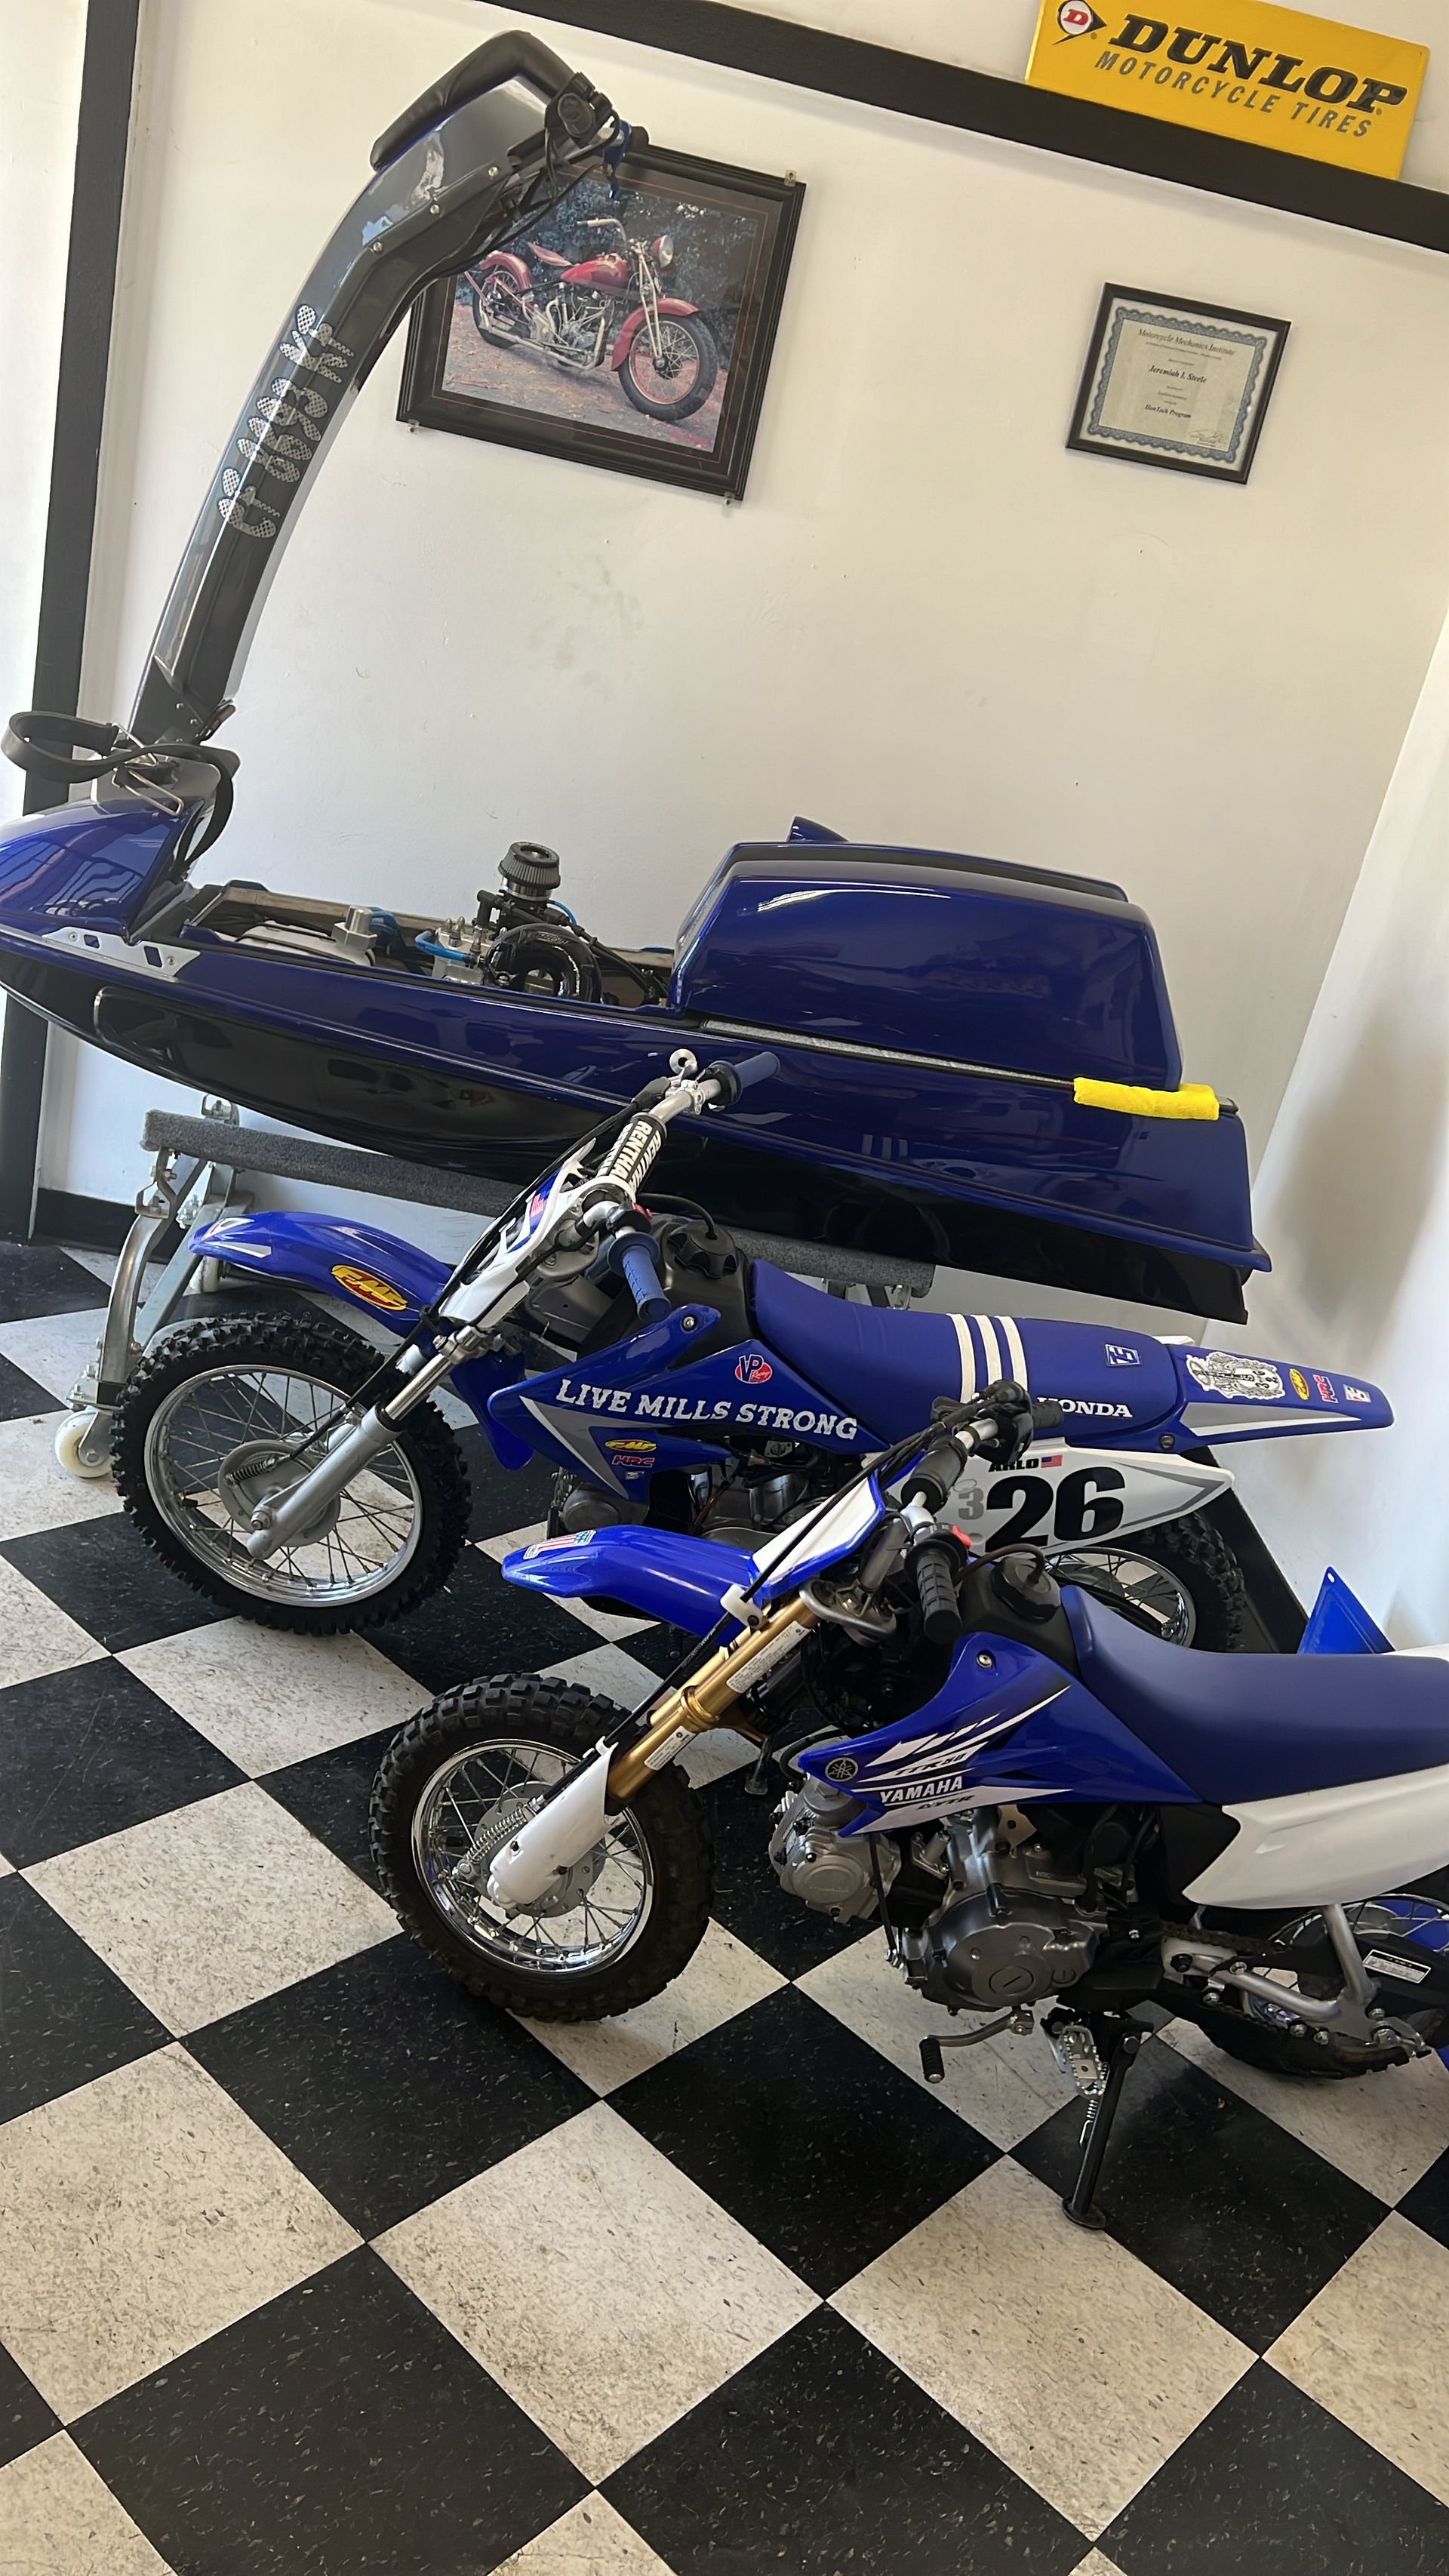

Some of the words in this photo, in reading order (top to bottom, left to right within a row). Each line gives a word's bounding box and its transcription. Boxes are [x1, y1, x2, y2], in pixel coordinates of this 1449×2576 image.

[1108, 14, 1408, 114] DUNLOP
[1094, 51, 1281, 114] MOTORCYCLE
[1291, 97, 1373, 138] TIRES
[1138, 328, 1174, 343] Motorcycle
[1175, 336, 1208, 349] Mechanics
[1208, 343, 1236, 356] Institute
[1149, 365, 1180, 378] Jeremiah
[1186, 373, 1208, 383] Steele
[217, 466, 281, 538] CF
[279, 304, 355, 383] KF
[609, 1120, 654, 1180] RENTHA
[629, 1129, 662, 1193] RENTHA
[739, 1353, 764, 1383] VP
[555, 1378, 631, 1412] LIVE
[635, 1394, 732, 1420] MILLS
[734, 1403, 859, 1440] STRONG
[1037, 1396, 1133, 1418] ONDA
[879, 1775, 963, 1804] YAMAHA
